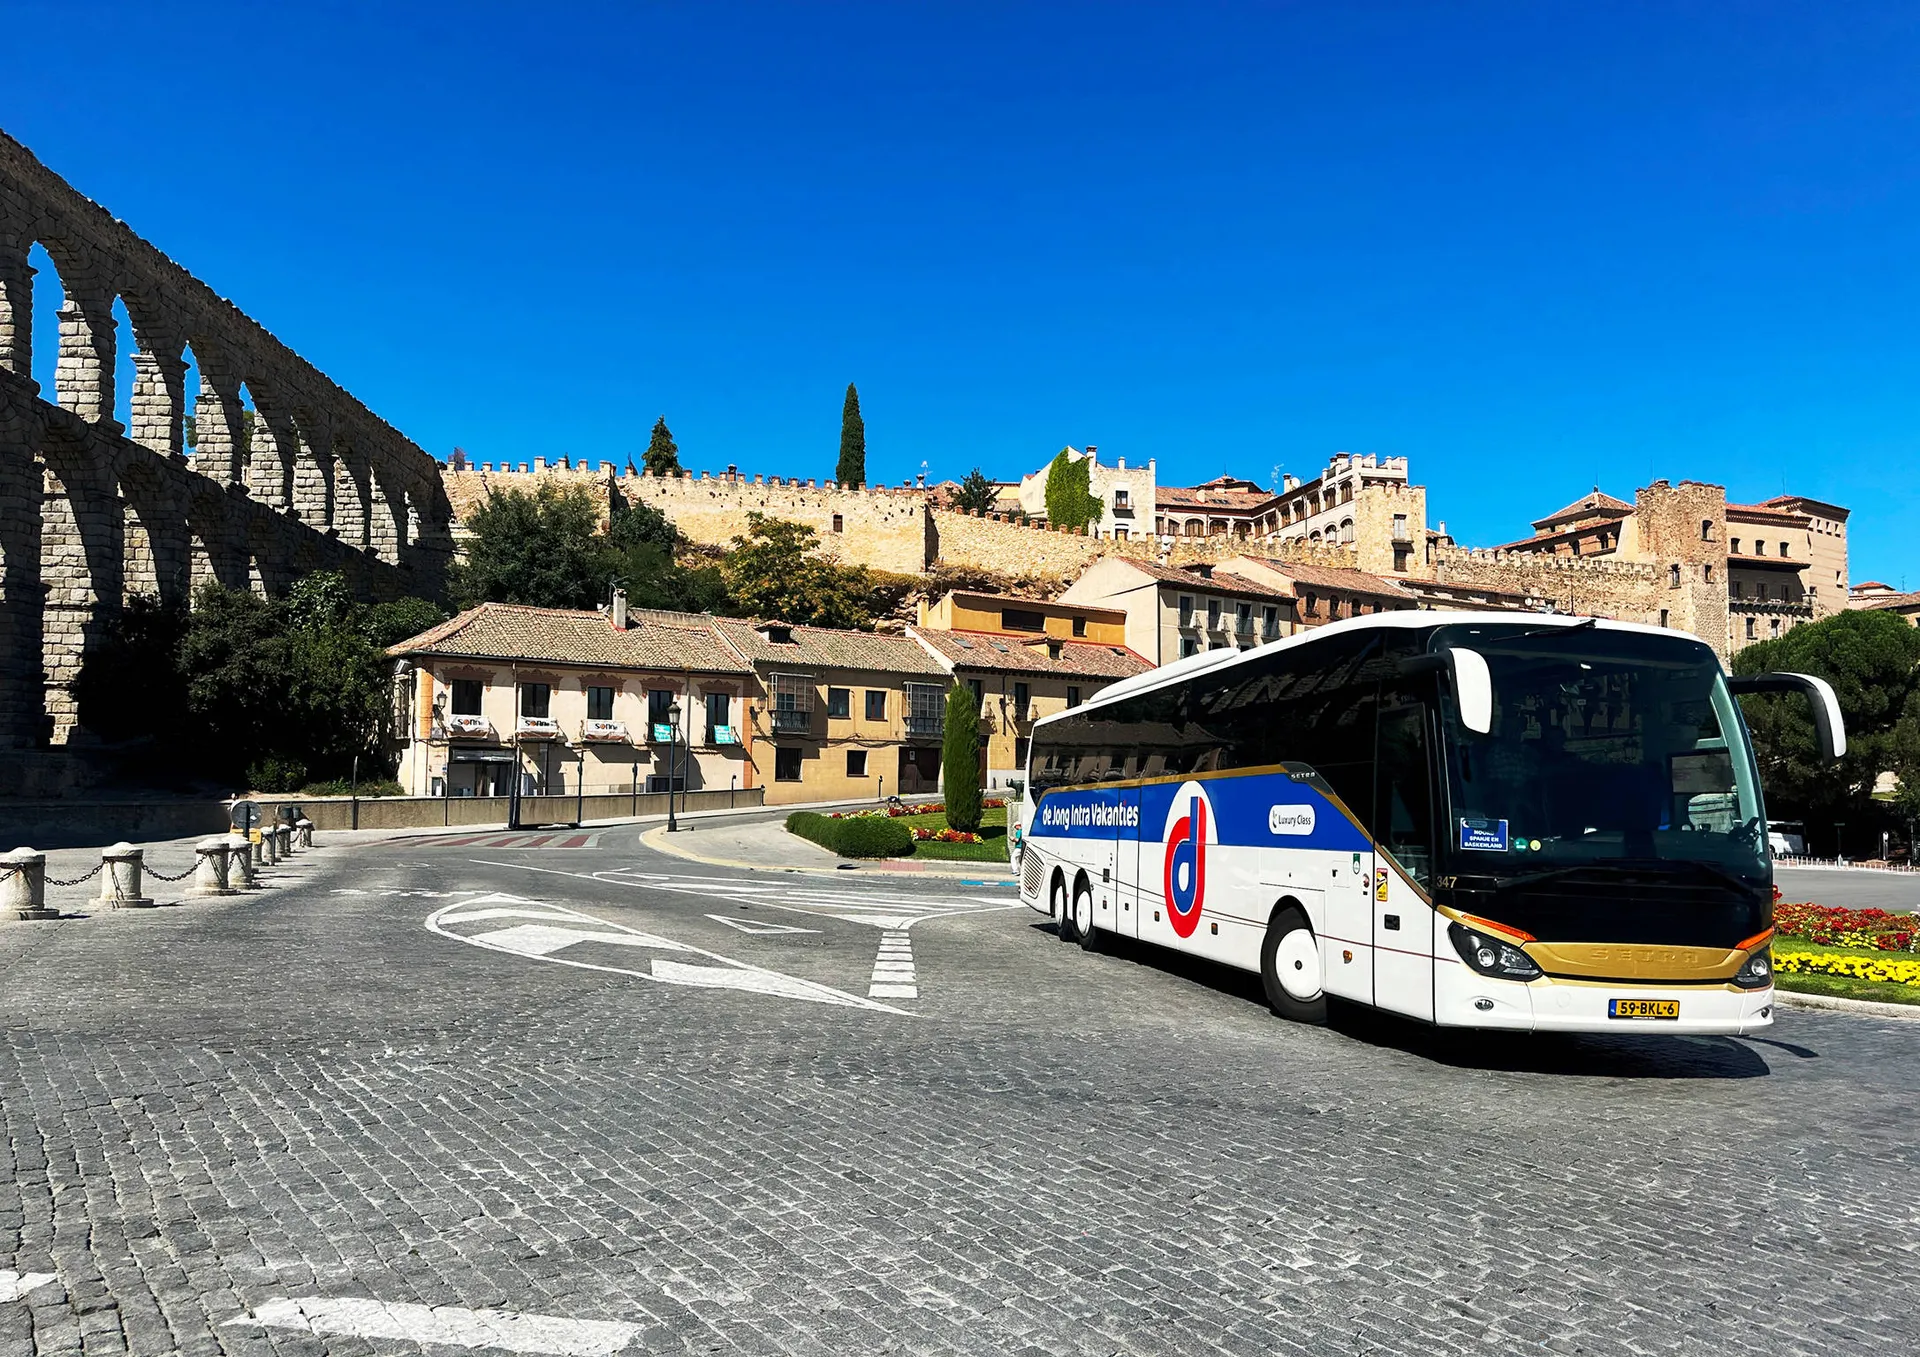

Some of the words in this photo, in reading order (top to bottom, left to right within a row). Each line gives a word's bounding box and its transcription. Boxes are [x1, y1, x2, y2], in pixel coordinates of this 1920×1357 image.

[1042, 803, 1052, 826] de
[1052, 805, 1070, 831] Jong
[1071, 804, 1090, 826] Intra
[1091, 799, 1139, 827] Vakanties
[1278, 815, 1296, 827] Luxury
[1297, 815, 1311, 825] Class
[1436, 876, 1457, 889] 347
[1590, 948, 1698, 963] SETRA
[1620, 1002, 1674, 1015] 59-BKL-6
